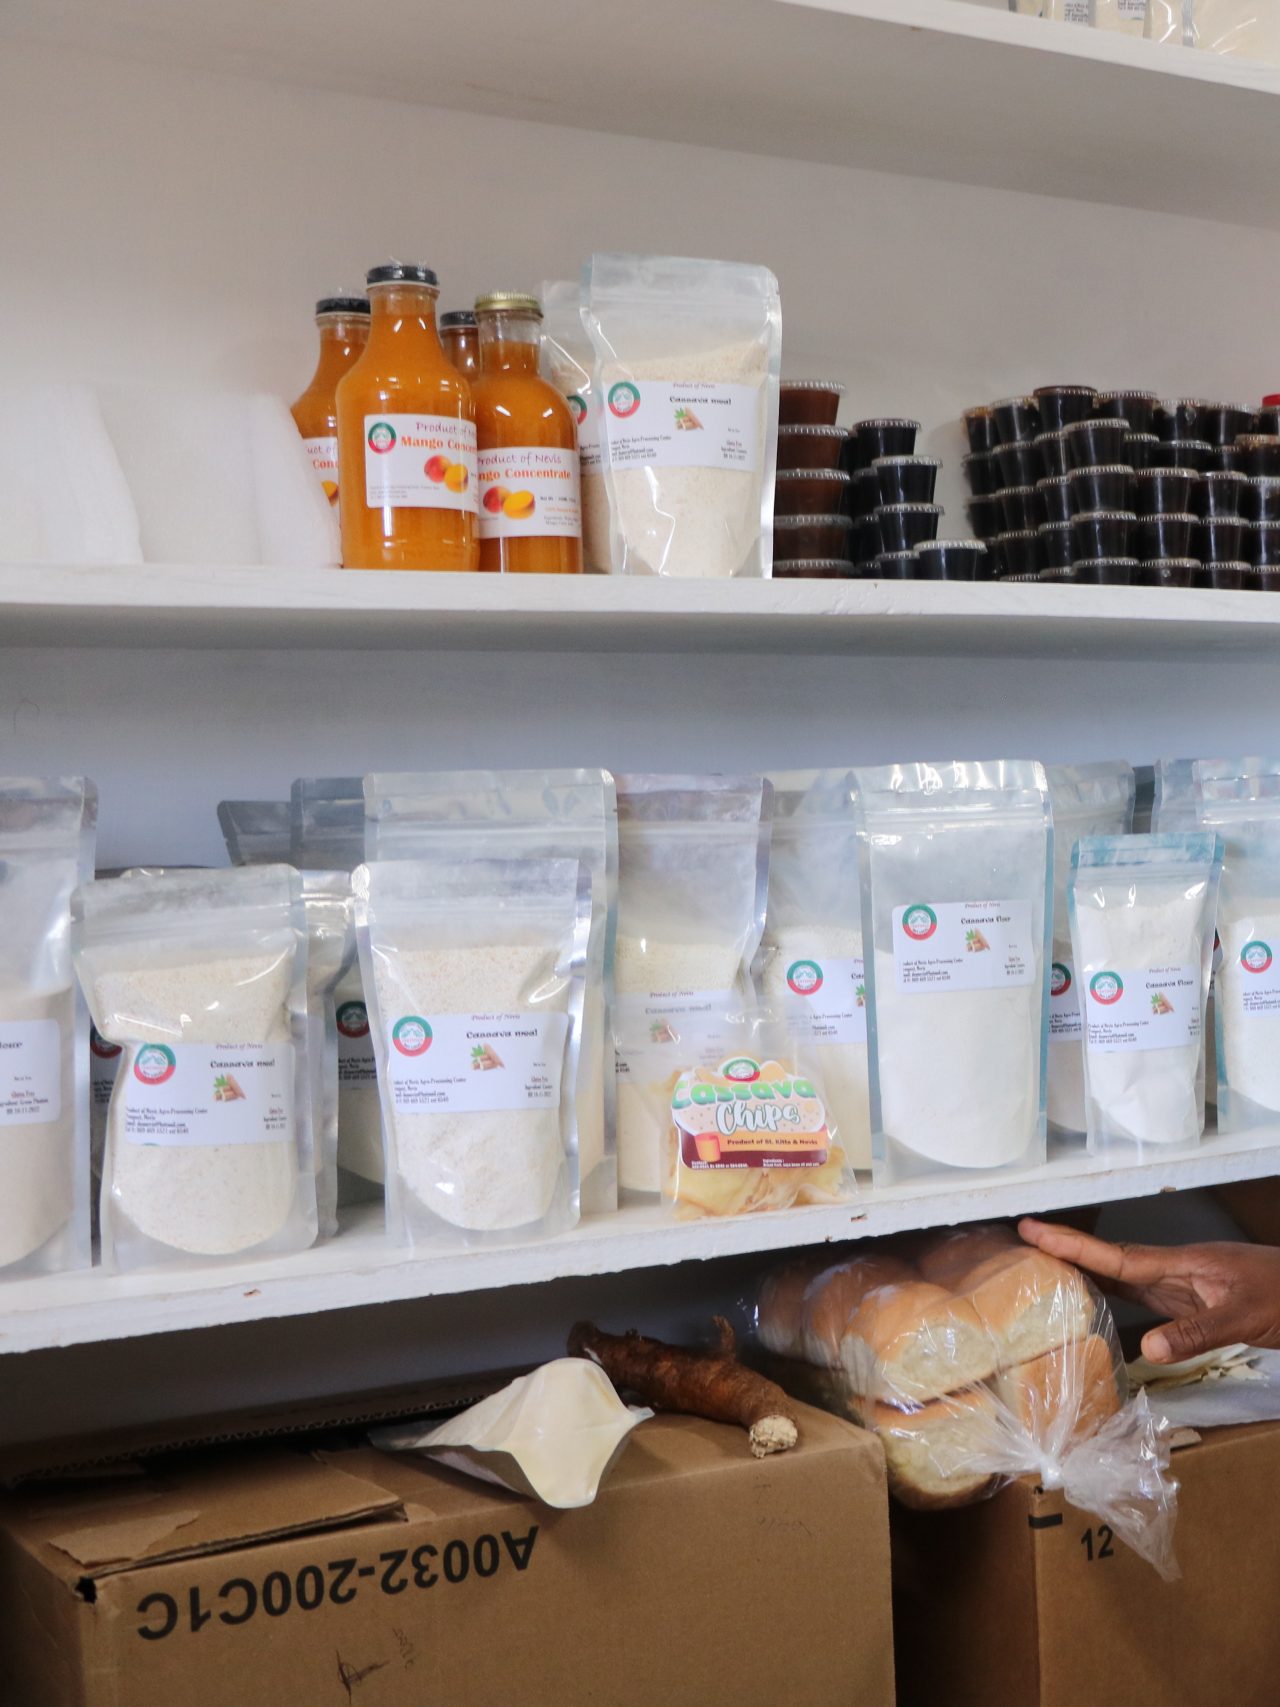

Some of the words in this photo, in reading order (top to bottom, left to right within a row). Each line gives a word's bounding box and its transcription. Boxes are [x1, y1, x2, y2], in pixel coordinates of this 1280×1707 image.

[400, 436, 443, 450] Mango
[505, 468, 571, 480] Concentrate
[535, 454, 562, 464] Nevis
[672, 1079, 816, 1110] Cassava
[716, 1100, 801, 1136] Chips
[1081, 1524, 1114, 1561] 12
[136, 1525, 540, 1641] A0032-200C1C
